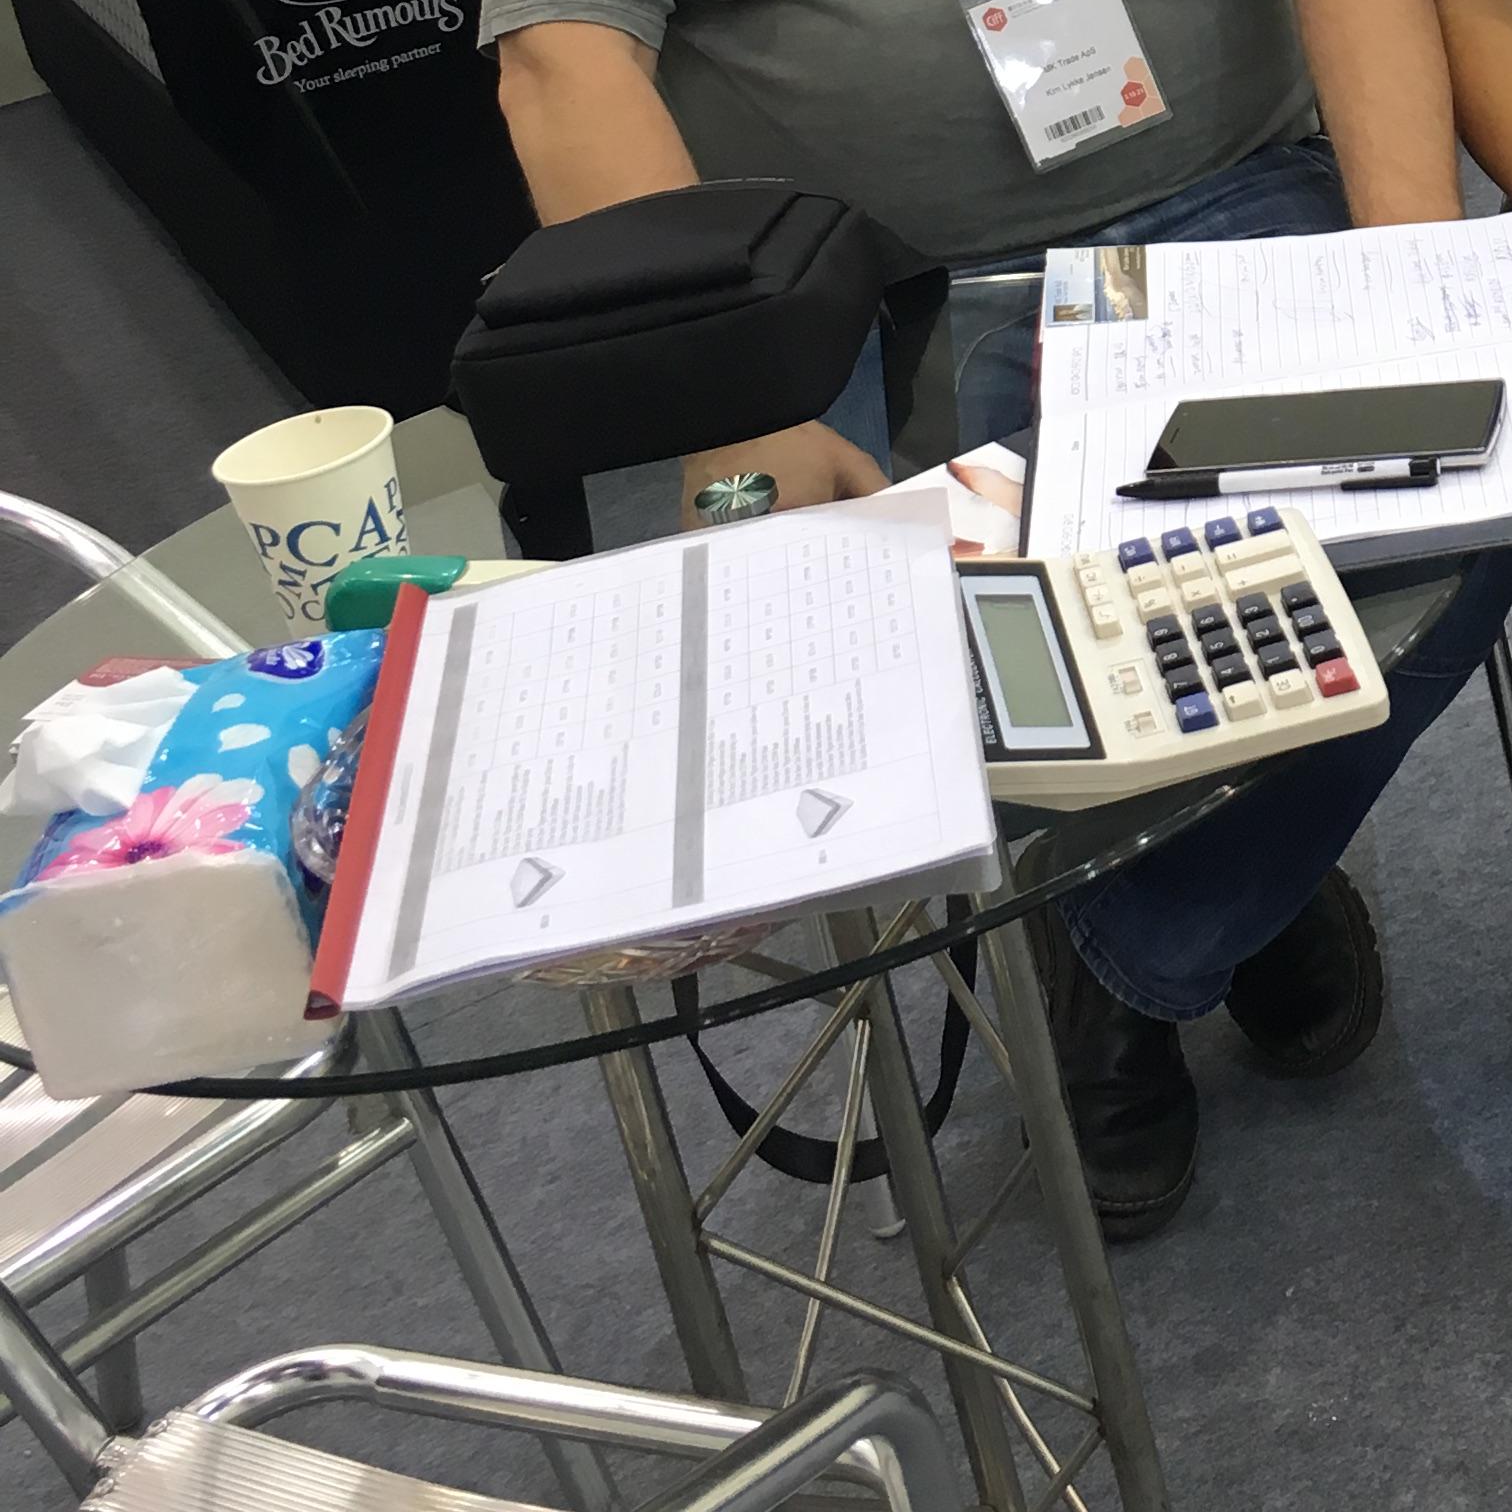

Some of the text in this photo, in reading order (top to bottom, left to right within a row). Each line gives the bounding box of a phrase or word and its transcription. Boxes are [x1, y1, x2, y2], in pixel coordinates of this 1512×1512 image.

[254, 20, 325, 85] Bed
[293, 42, 442, 93] Your sleeping partner
